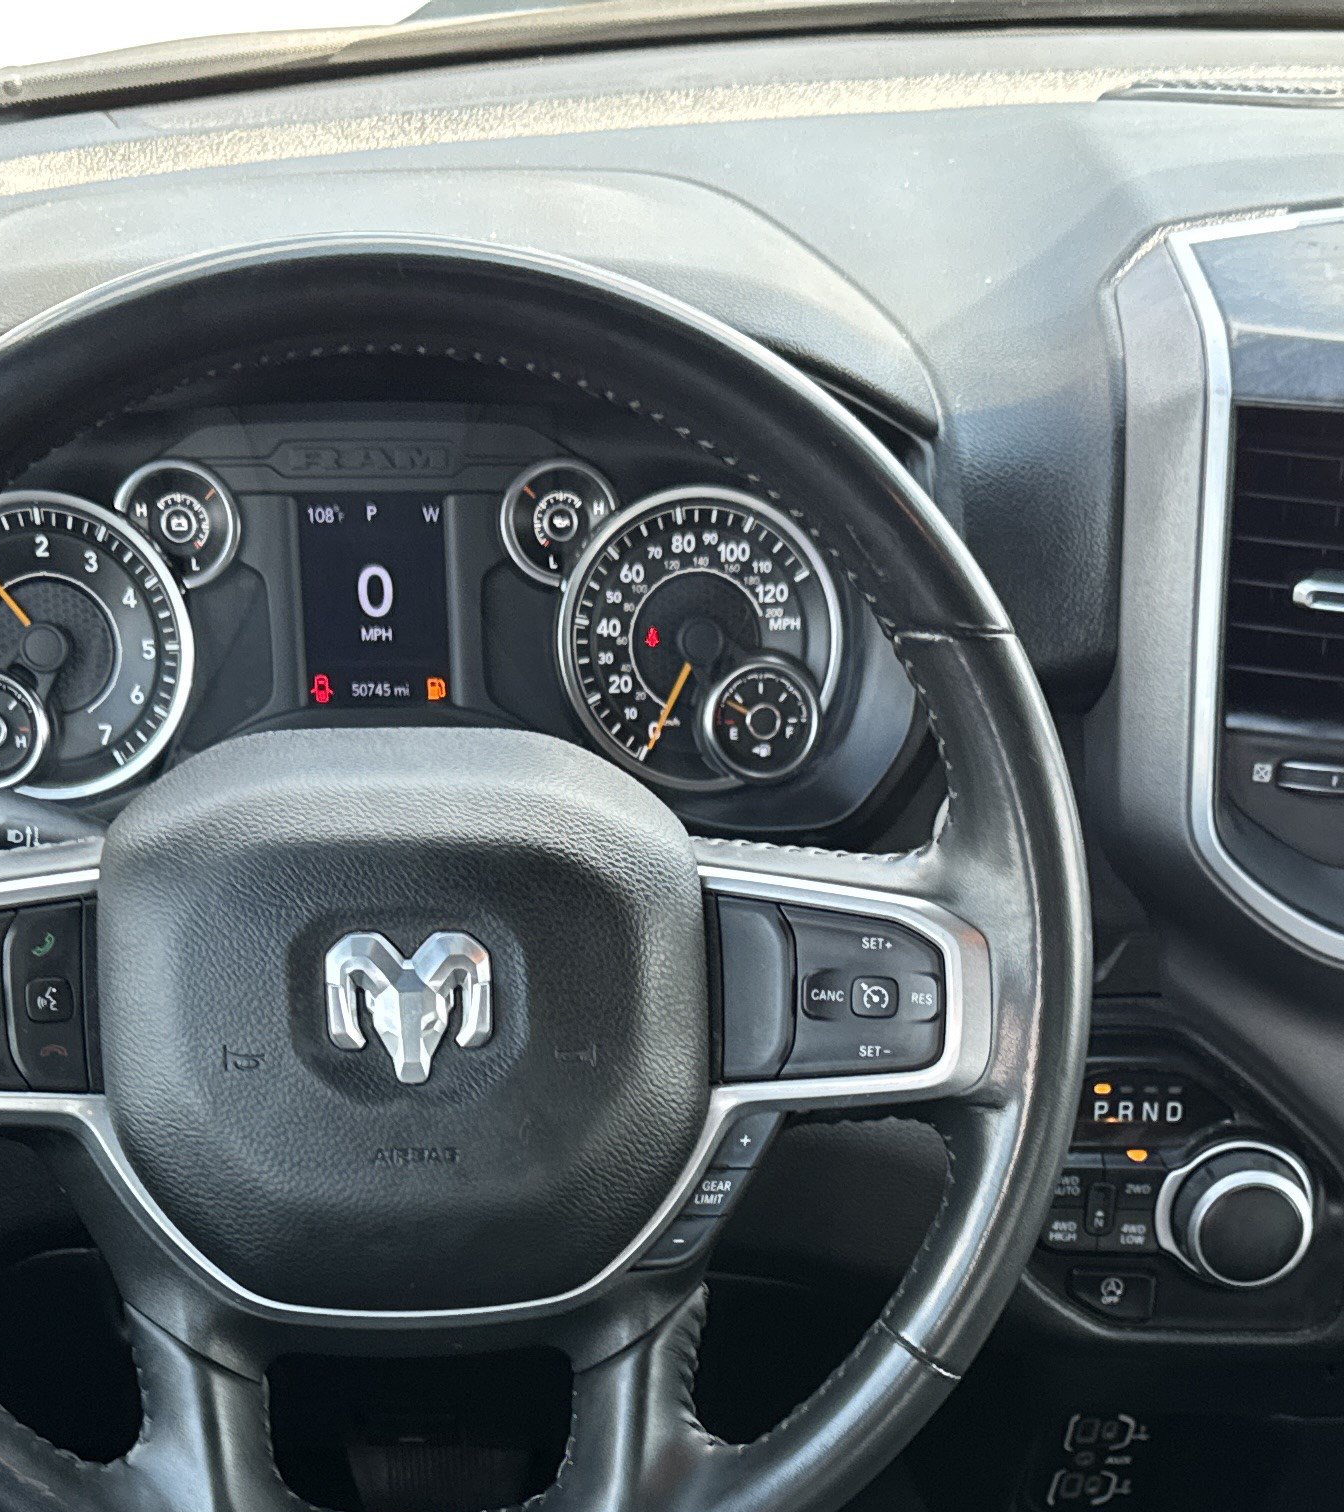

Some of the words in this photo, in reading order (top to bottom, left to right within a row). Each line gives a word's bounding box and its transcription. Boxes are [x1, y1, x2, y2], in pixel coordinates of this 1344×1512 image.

[135, 503, 147, 517] H
[366, 505, 378, 521] P
[422, 506, 440, 522] W
[592, 502, 604, 515] H
[671, 533, 695, 553] 80
[702, 532, 718, 545] 90
[35, 535, 49, 557] 2
[647, 546, 663, 559] 70
[717, 541, 750, 562] 100
[84, 552, 98, 572] 3
[191, 557, 200, 571] L
[549, 557, 557, 570] L
[752, 560, 772, 573] 110
[620, 563, 645, 583] 60
[357, 563, 393, 618] 0
[606, 591, 622, 604] 50
[755, 583, 788, 603] 120
[122, 588, 137, 608] 4
[597, 617, 621, 637] 40
[768, 618, 801, 631] MPH
[360, 626, 393, 642] MPH
[142, 640, 155, 660] 5
[598, 651, 614, 665] 30
[351, 683, 391, 697] 50745
[394, 684, 410, 697] mi
[609, 674, 632, 694] 20
[130, 686, 144, 704] 6
[624, 707, 638, 719] 10
[99, 725, 112, 745] 7
[729, 727, 738, 740] E
[785, 726, 795, 739] F
[15, 735, 27, 748] H
[811, 989, 844, 1002] CANC
[911, 992, 933, 1005] RES
[1094, 1101, 1109, 1122] P
[1118, 1101, 1133, 1122] R
[1142, 1101, 1159, 1122] N
[1166, 1101, 1183, 1122] D
[702, 1181, 732, 1192] GEAR
[694, 1194, 724, 1204] LIMIT
[1052, 1221, 1077, 1232] 4WD
[1121, 1224, 1146, 1235] 4WD
